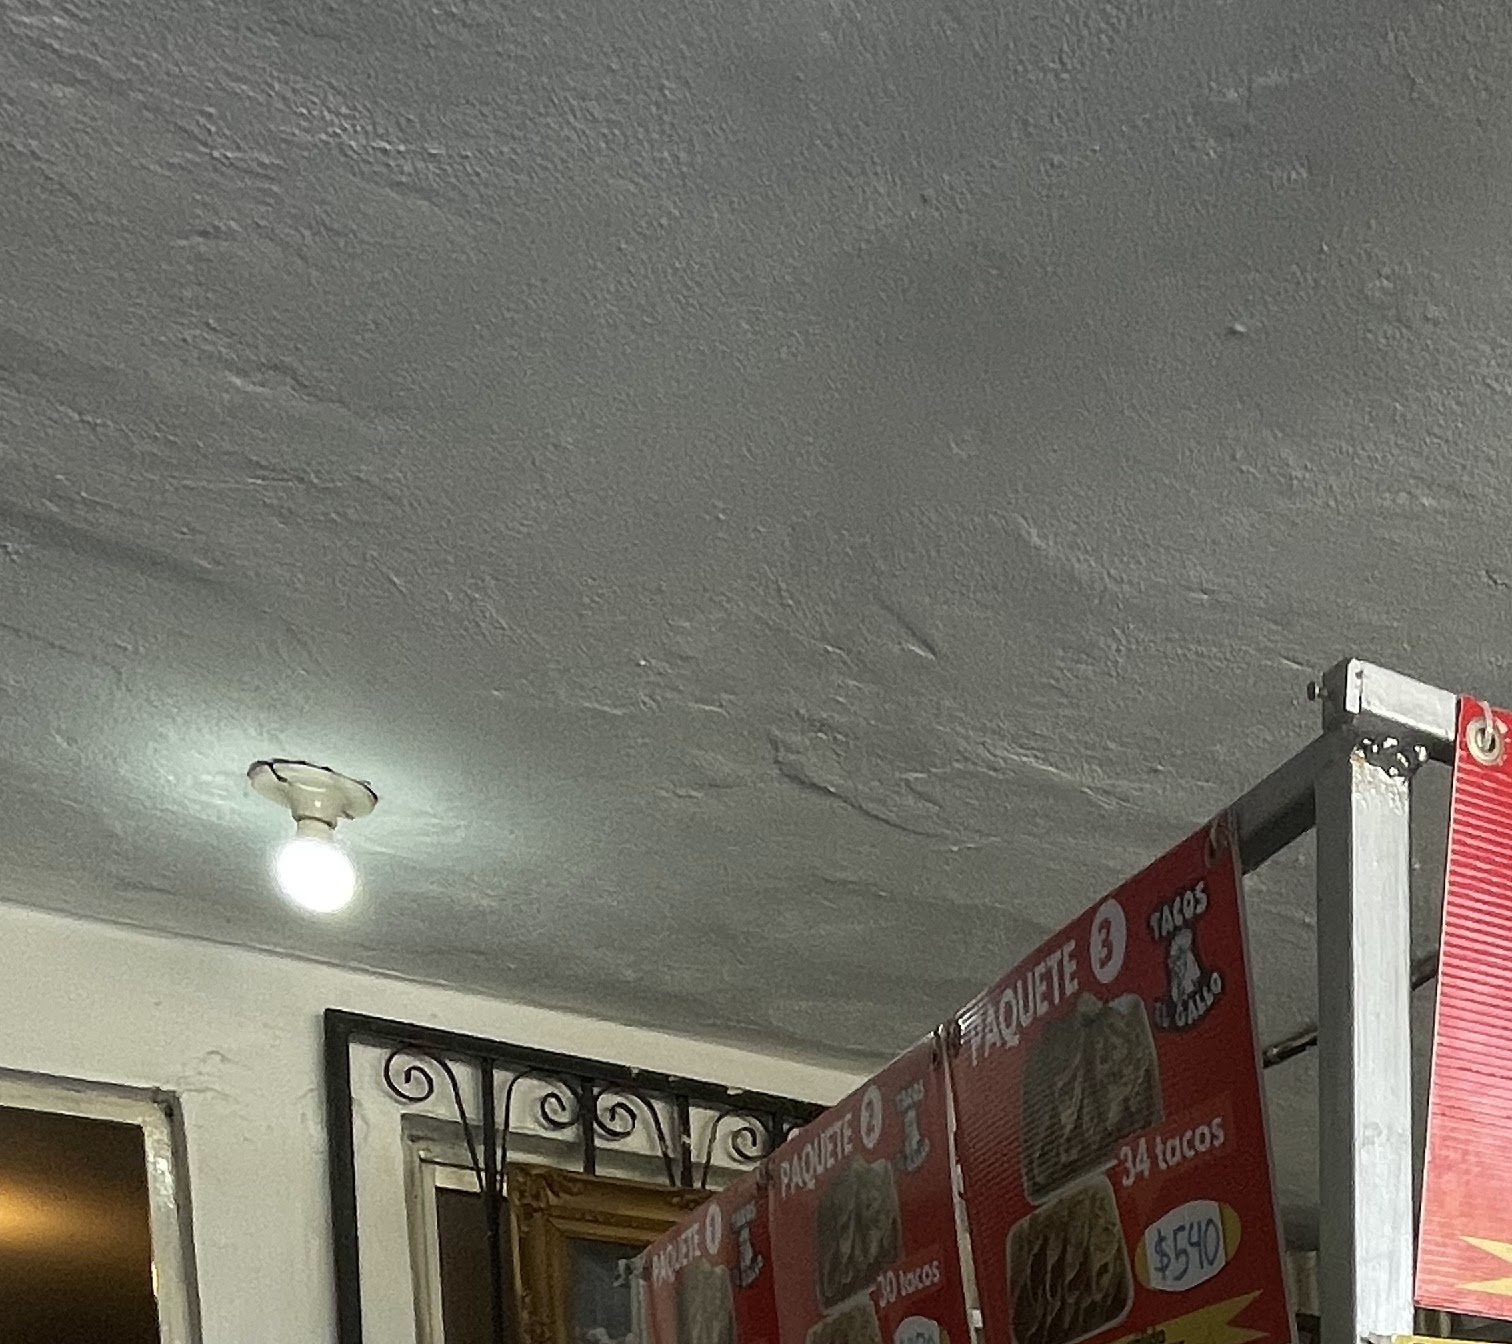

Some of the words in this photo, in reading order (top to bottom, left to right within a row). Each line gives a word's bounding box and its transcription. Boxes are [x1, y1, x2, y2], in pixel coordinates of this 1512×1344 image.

[1150, 880, 1208, 940] TACOS
[966, 939, 1079, 1066] PAQUETE
[1098, 918, 1114, 971] 3
[1175, 972, 1222, 1027] GALLO
[779, 1113, 854, 1197] PAQUETE
[1120, 1137, 1150, 1187] 34
[1154, 1117, 1225, 1170] tacos
[1154, 1218, 1221, 1281] $540
